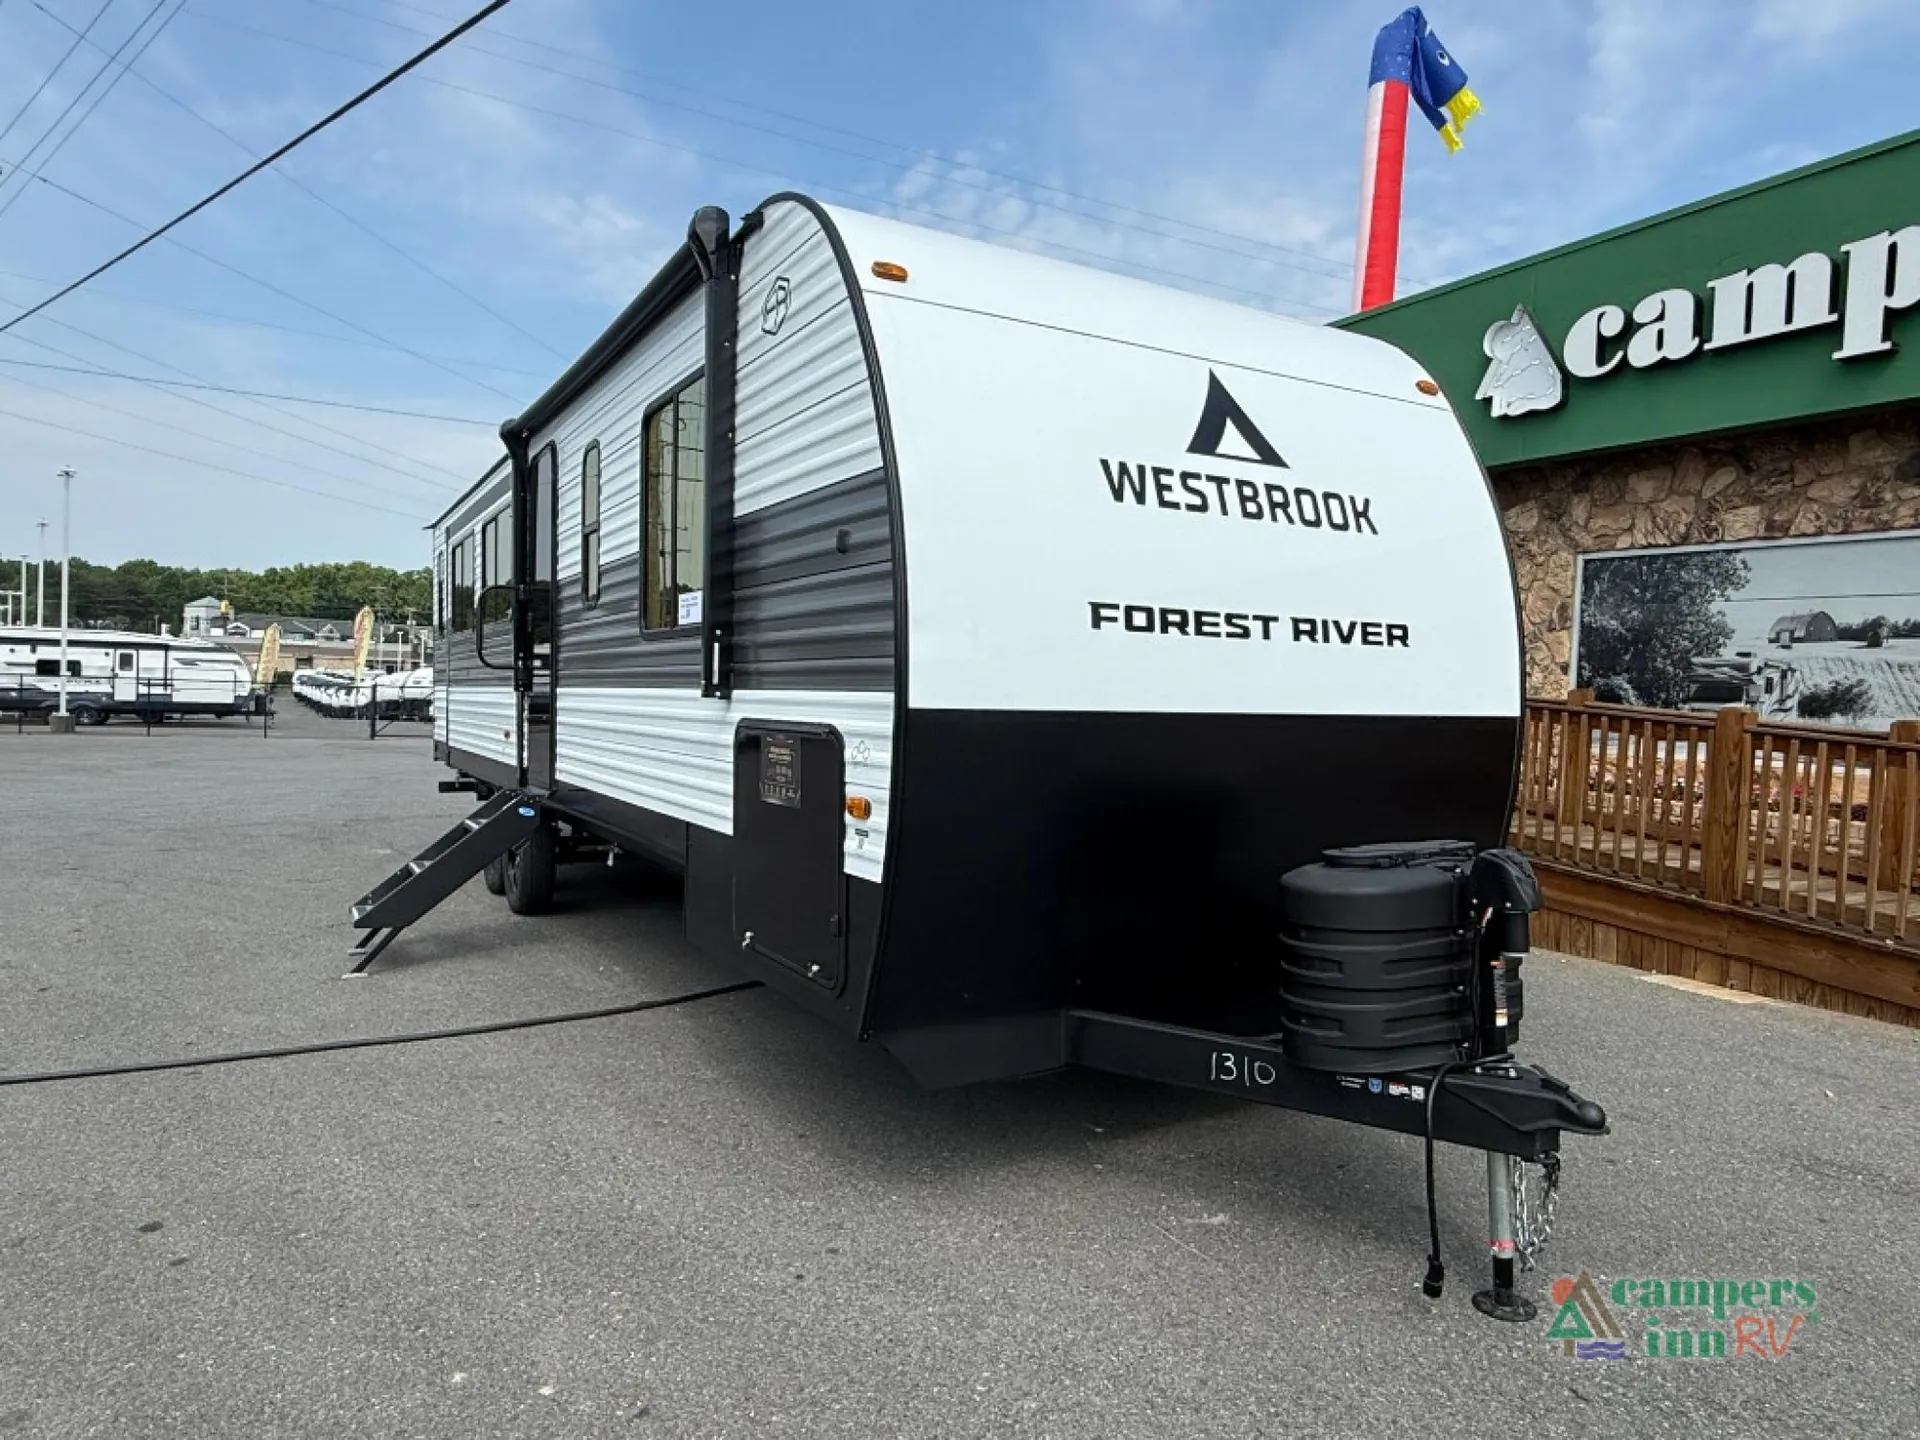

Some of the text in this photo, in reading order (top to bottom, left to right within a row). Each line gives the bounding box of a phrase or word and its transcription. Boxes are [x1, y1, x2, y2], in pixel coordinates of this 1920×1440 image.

[1563, 224, 1920, 378] camp
[1099, 458, 1379, 535] WESTBROOK
[1087, 601, 1411, 647] FOREST RIVER
[1210, 1051, 1277, 1087] 1310
